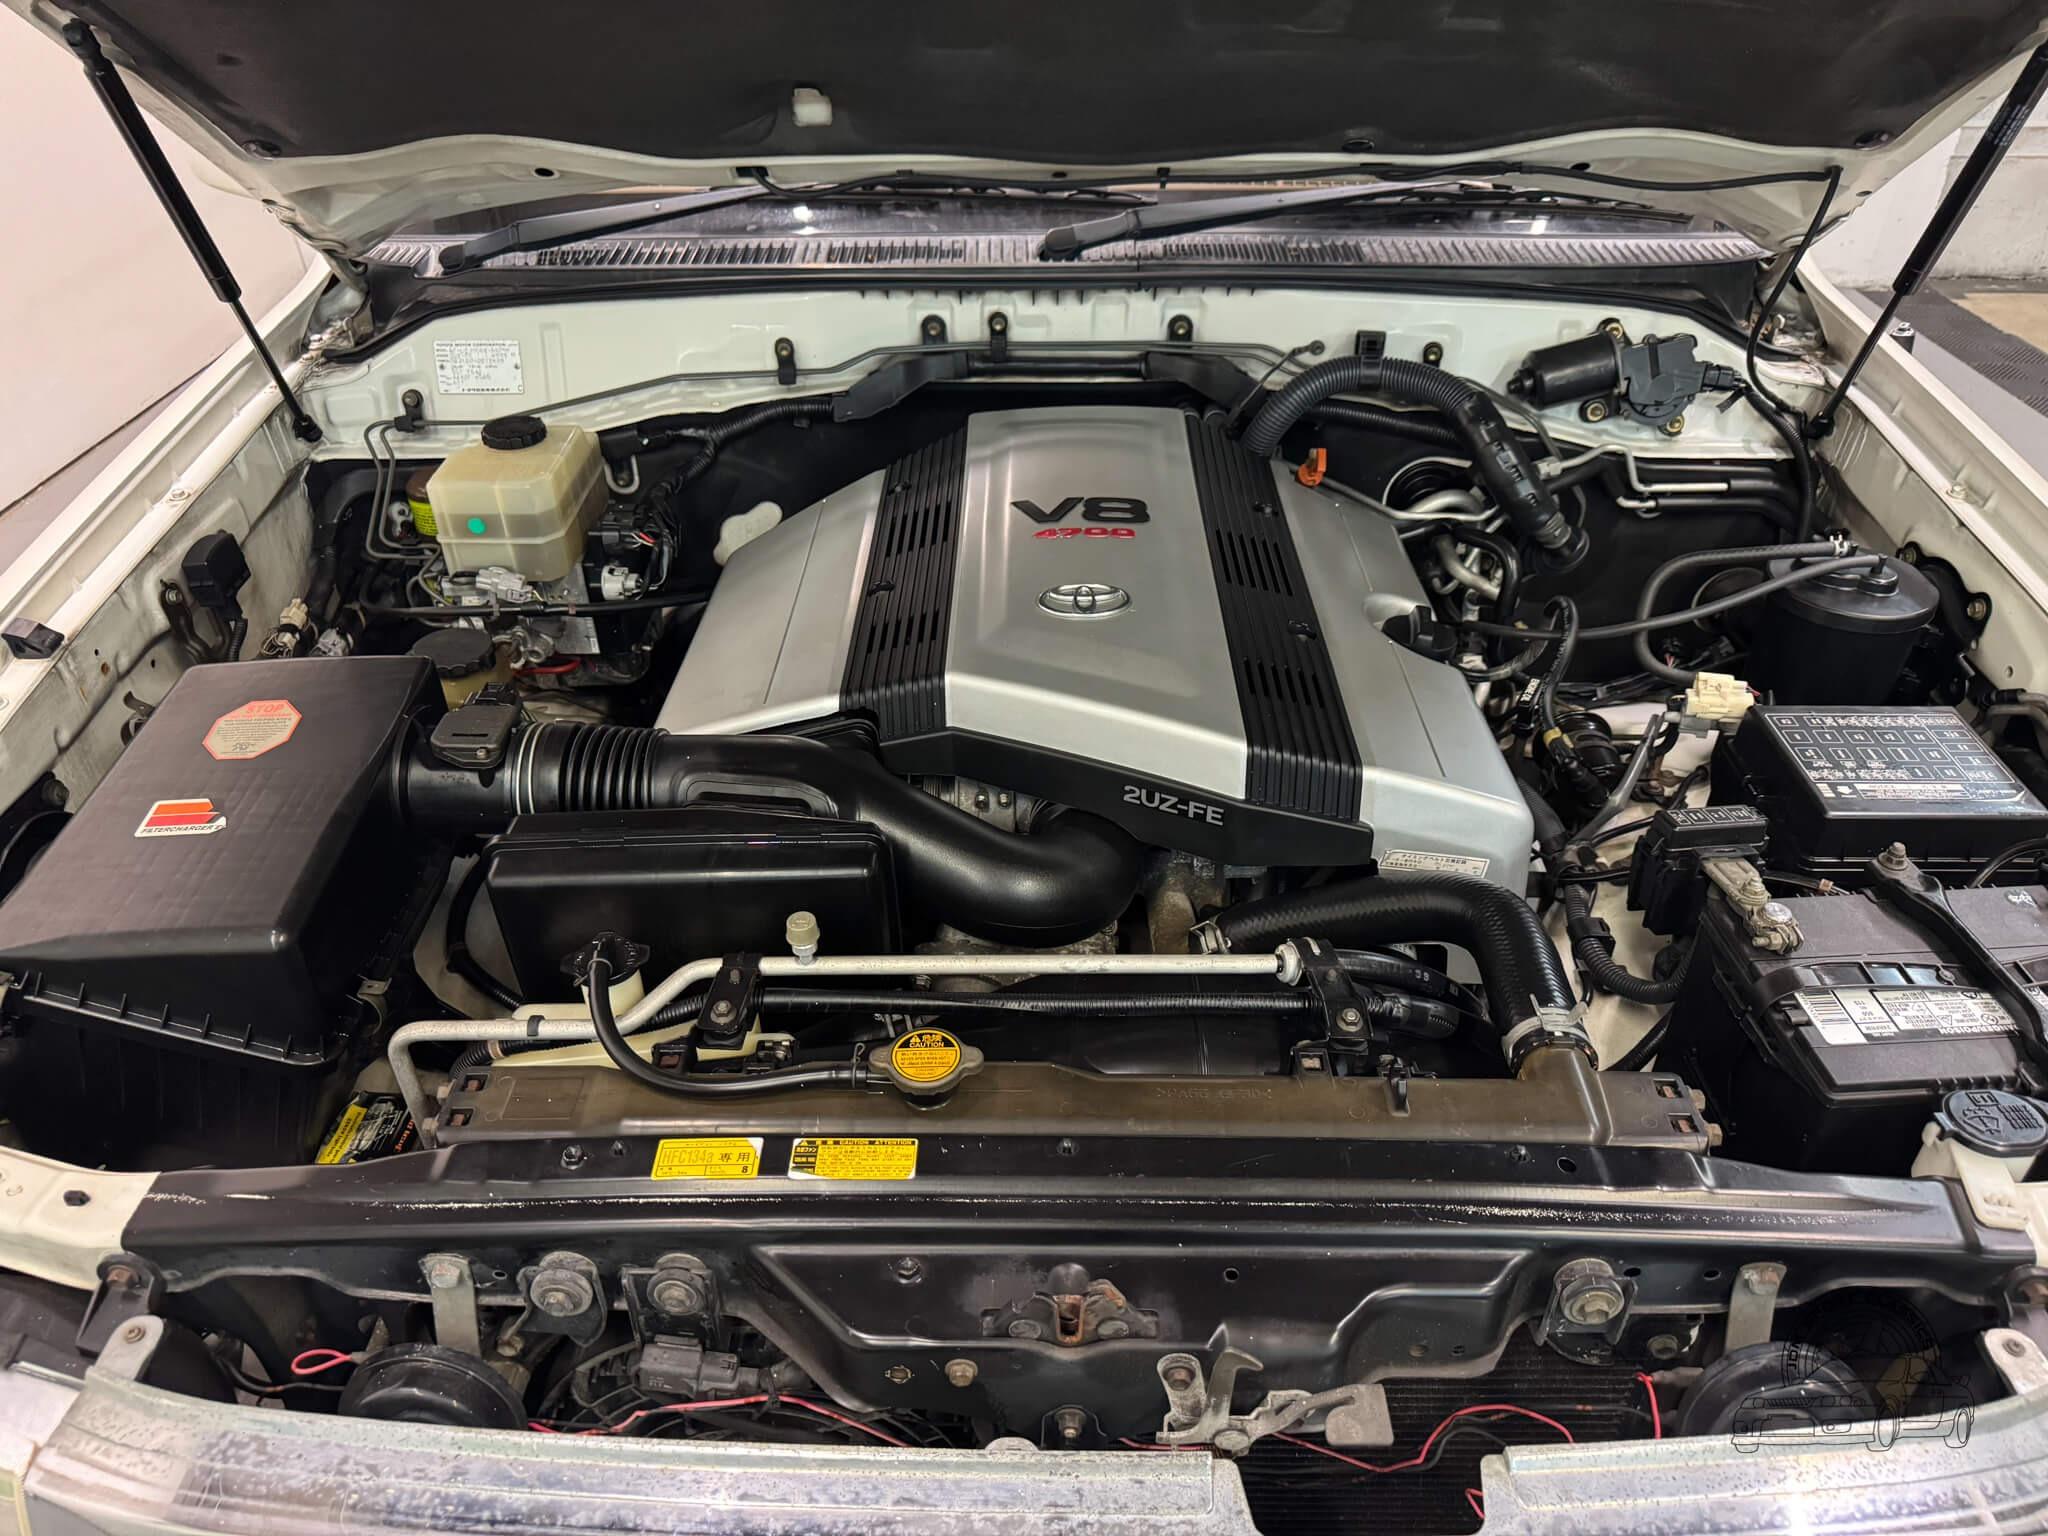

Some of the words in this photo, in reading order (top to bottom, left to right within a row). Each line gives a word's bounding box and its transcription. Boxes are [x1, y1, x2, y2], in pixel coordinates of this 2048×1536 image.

[1010, 497, 1150, 523] V8
[1033, 528, 1136, 539] 4700
[245, 704, 285, 714] STOP
[1123, 785, 1224, 826] 2UZ-FE
[662, 1150, 714, 1164] HFC134a
